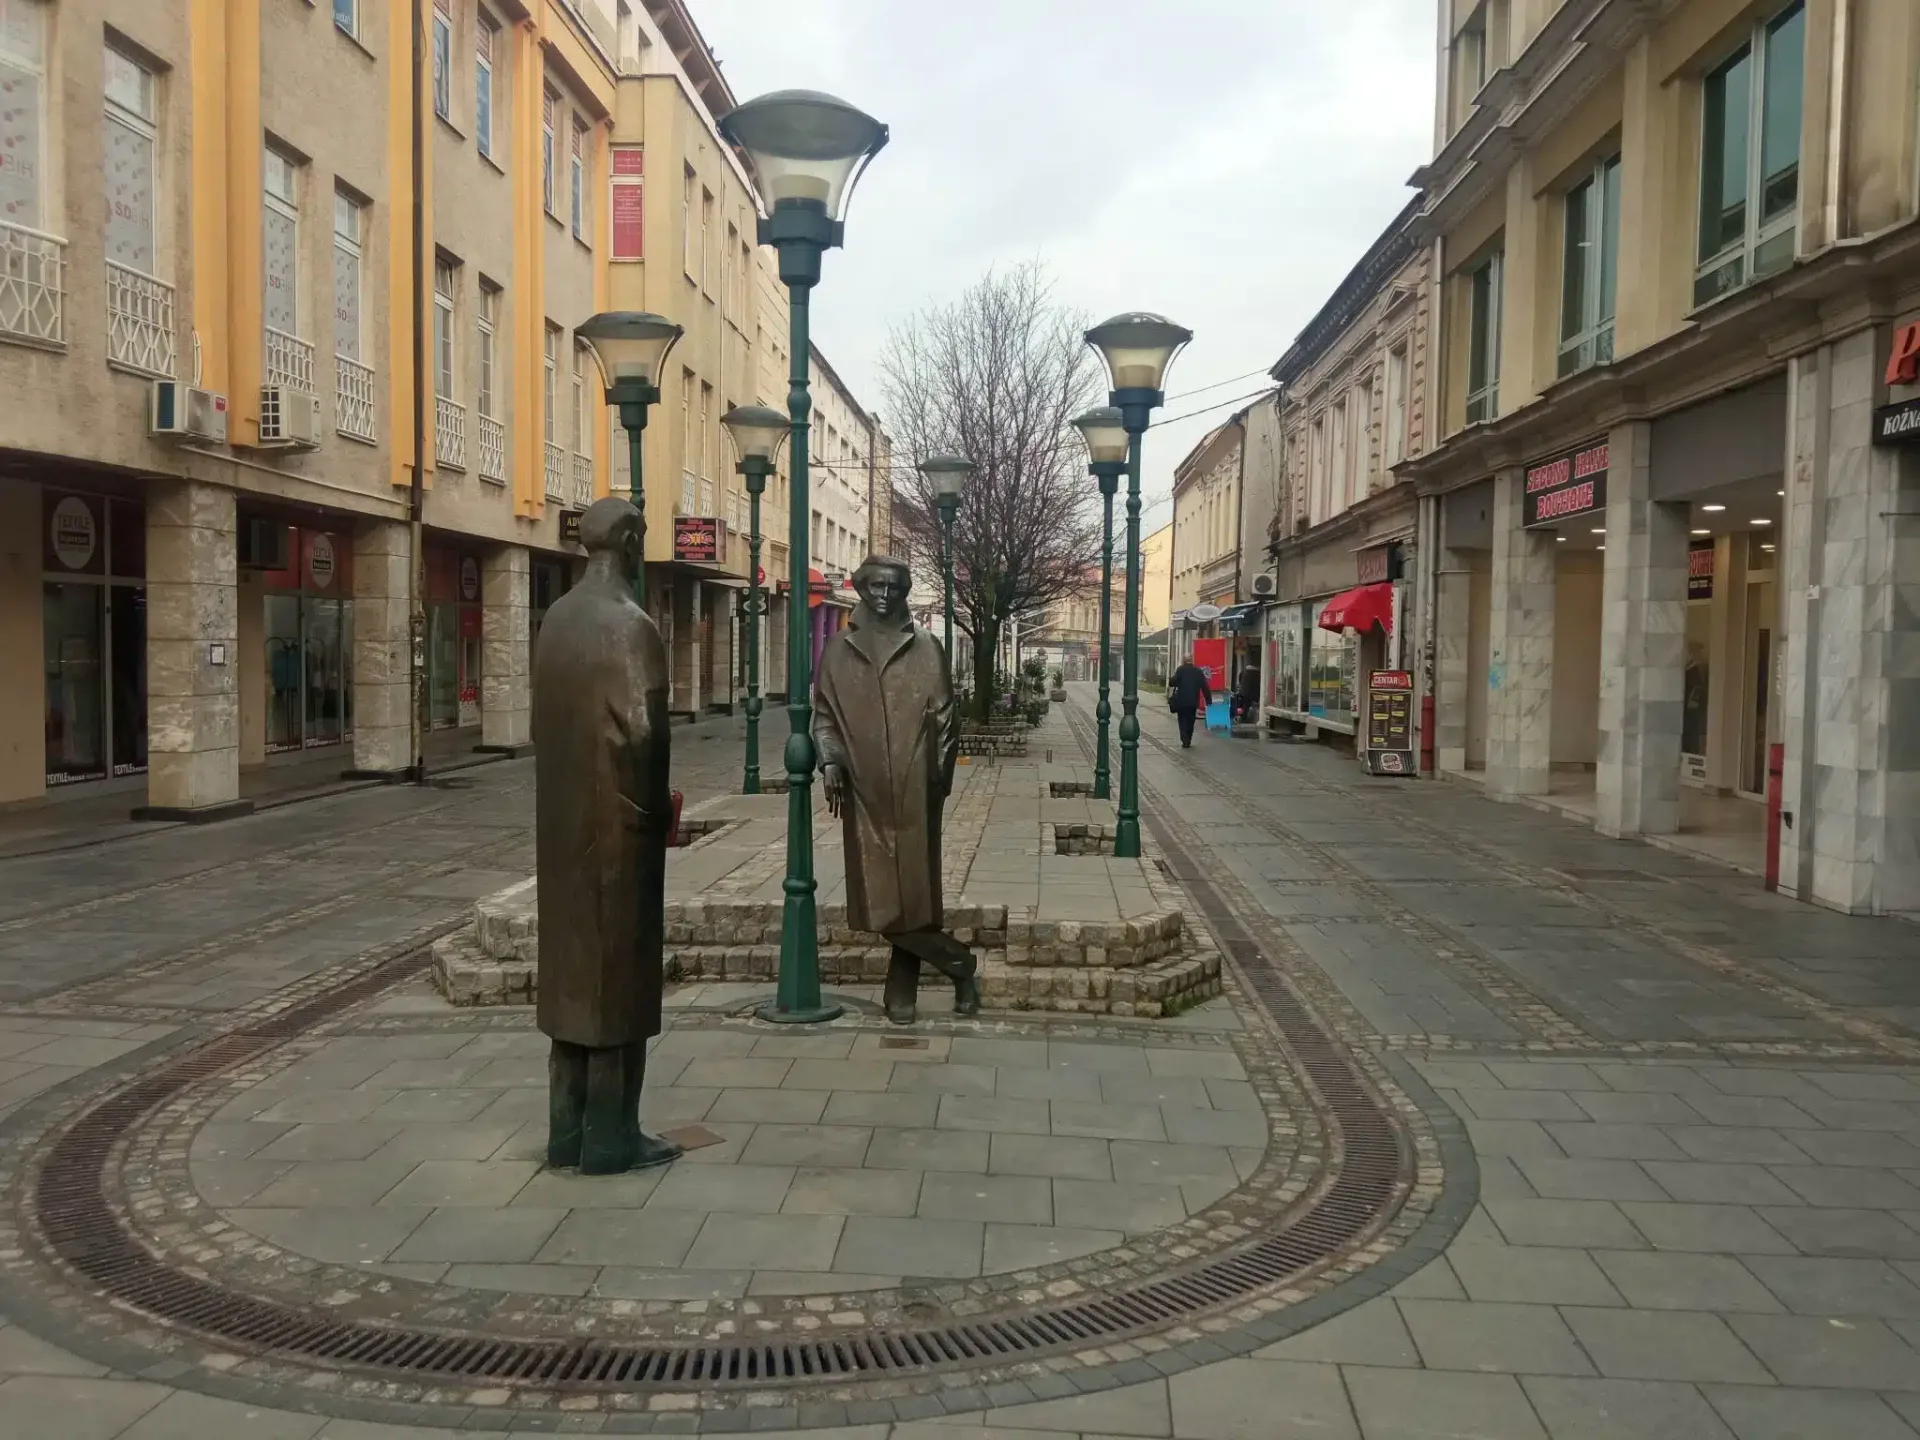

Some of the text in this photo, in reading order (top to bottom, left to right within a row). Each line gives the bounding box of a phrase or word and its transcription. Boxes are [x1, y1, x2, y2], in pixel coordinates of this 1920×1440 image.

[1526, 458, 1570, 493] SECOND
[1536, 481, 1594, 519] BOUTIQUE
[1373, 676, 1398, 684] CENTAR
[114, 763, 133, 775] TEXTILE
[47, 772, 68, 785] TEXTILE
